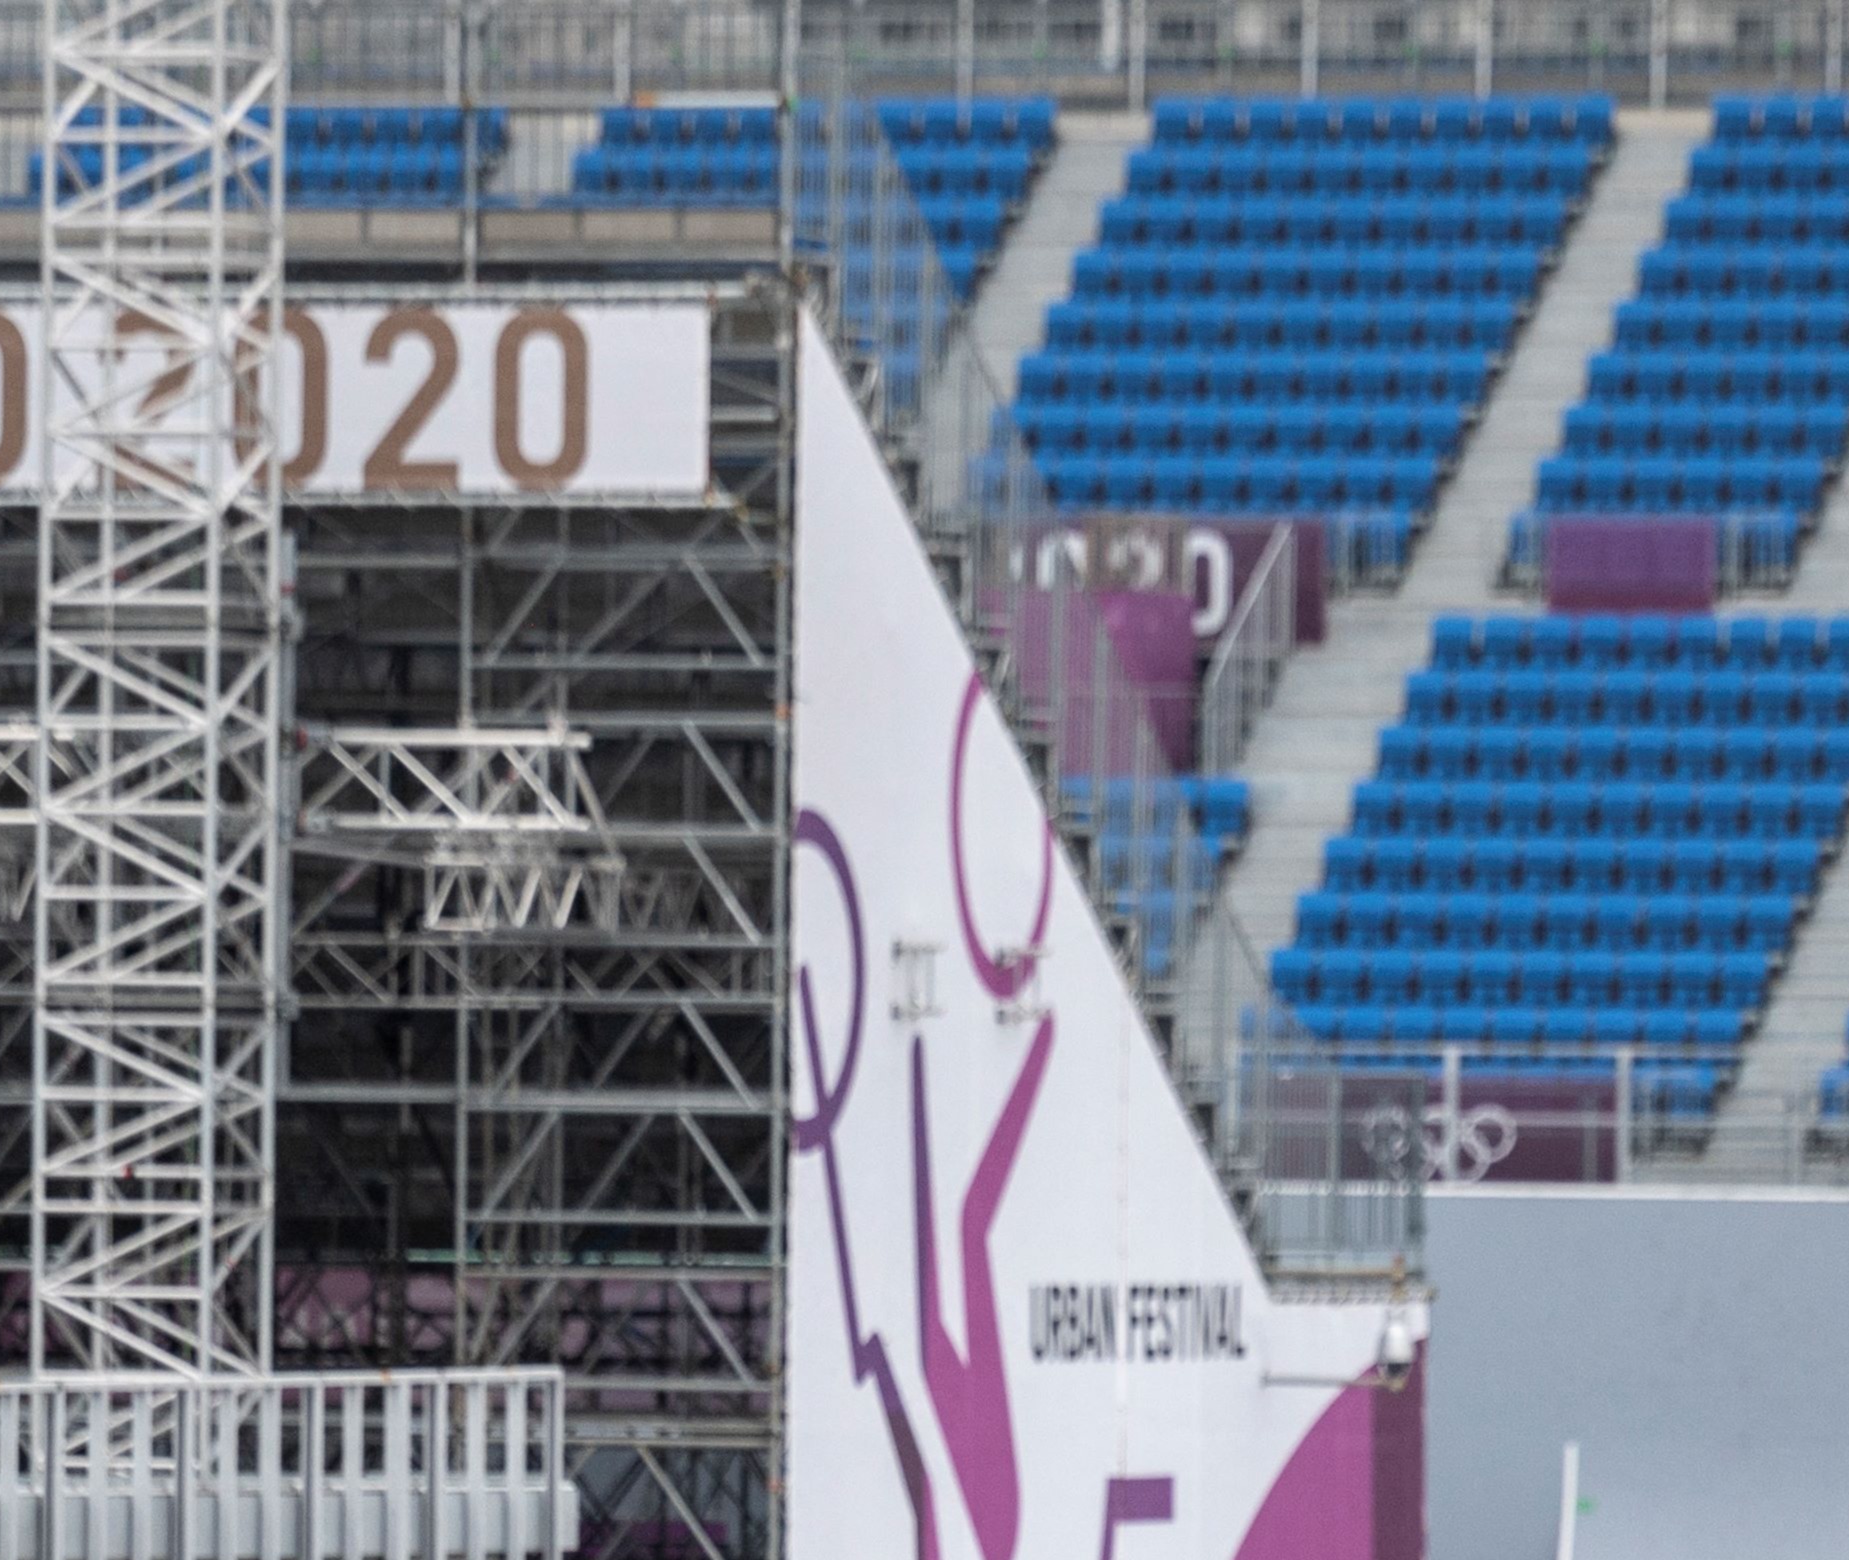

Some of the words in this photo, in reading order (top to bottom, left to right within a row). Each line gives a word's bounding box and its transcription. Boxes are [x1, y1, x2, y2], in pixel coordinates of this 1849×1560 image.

[99, 305, 588, 490] 2020
[1029, 1285, 1116, 1362] URBAN
[1126, 1285, 1246, 1362] FESTIVAL
